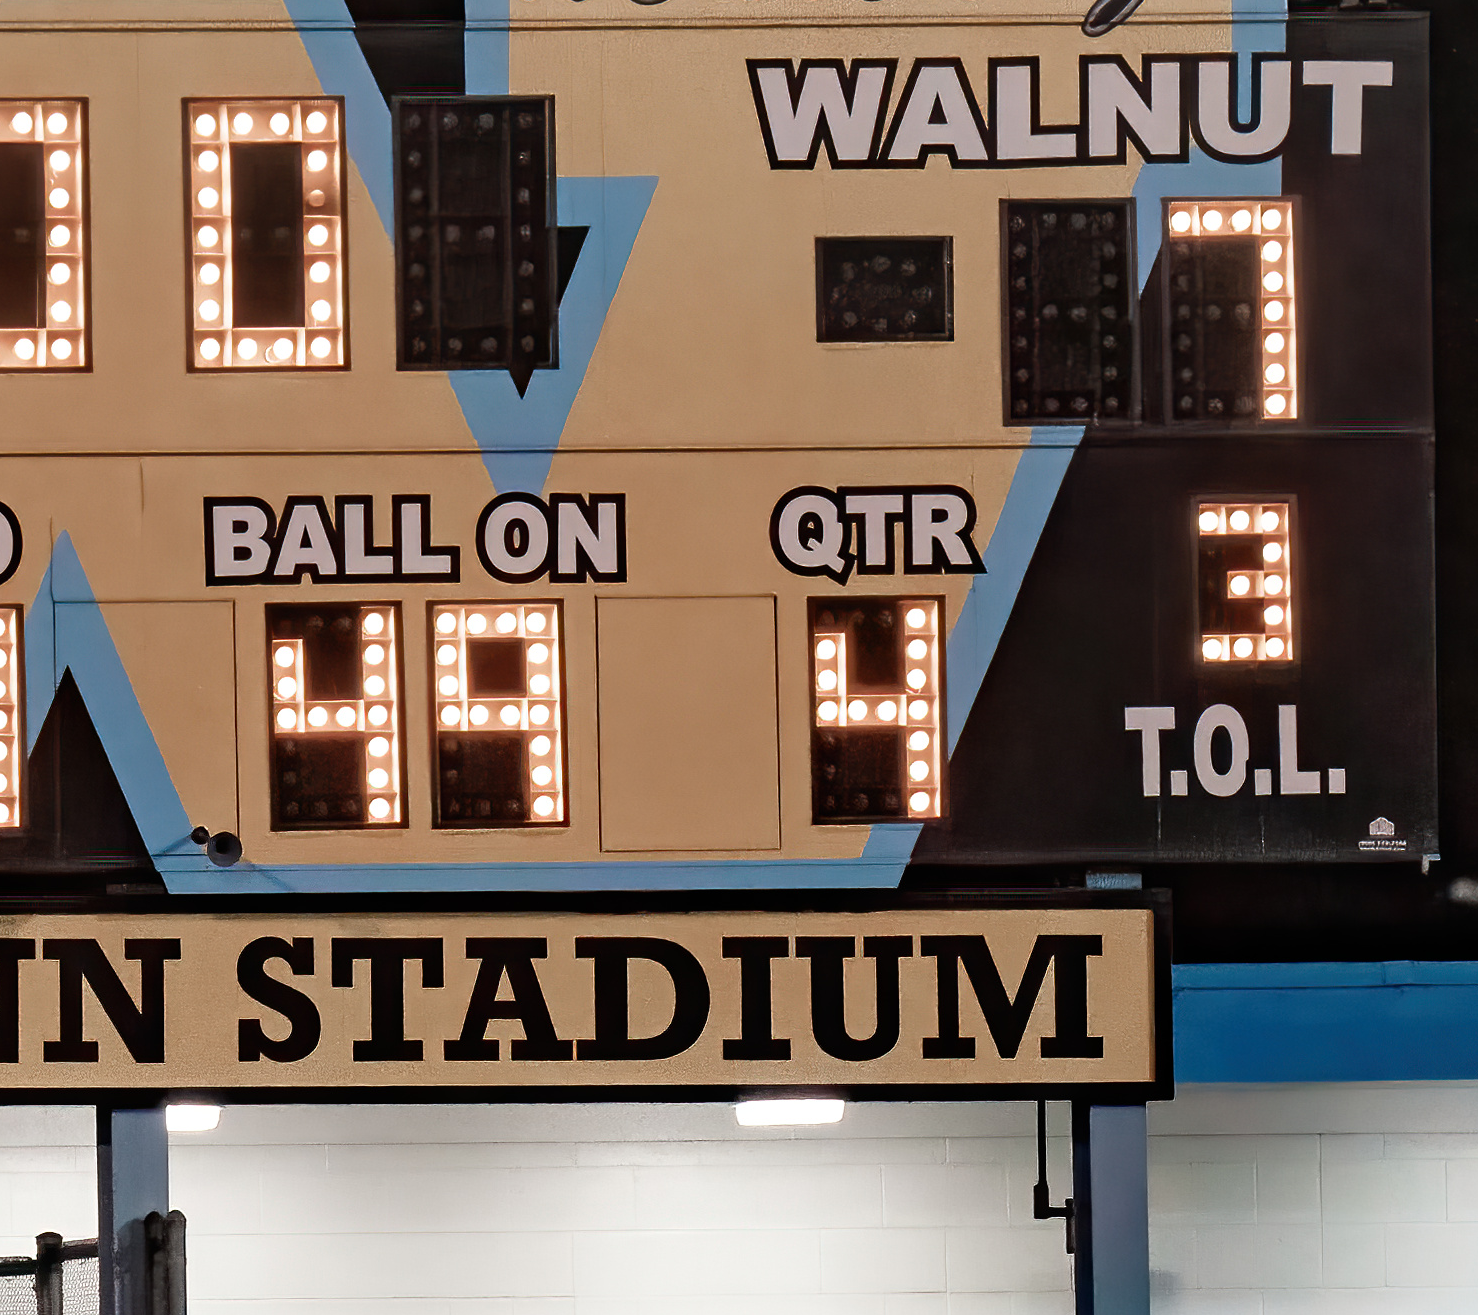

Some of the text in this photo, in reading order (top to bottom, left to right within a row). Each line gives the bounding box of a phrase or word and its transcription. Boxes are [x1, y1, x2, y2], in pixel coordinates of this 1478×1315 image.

[746, 53, 1394, 170] WALNUT
[1167, 201, 1298, 421] 7
[204, 494, 627, 585] BALL ON
[769, 485, 987, 587] QTR
[1197, 504, 1294, 662] 3
[270, 601, 564, 828] 49
[814, 598, 942, 819] 4
[1125, 704, 1346, 797] T.O.L.
[236, 933, 1105, 1063] STADIUM
